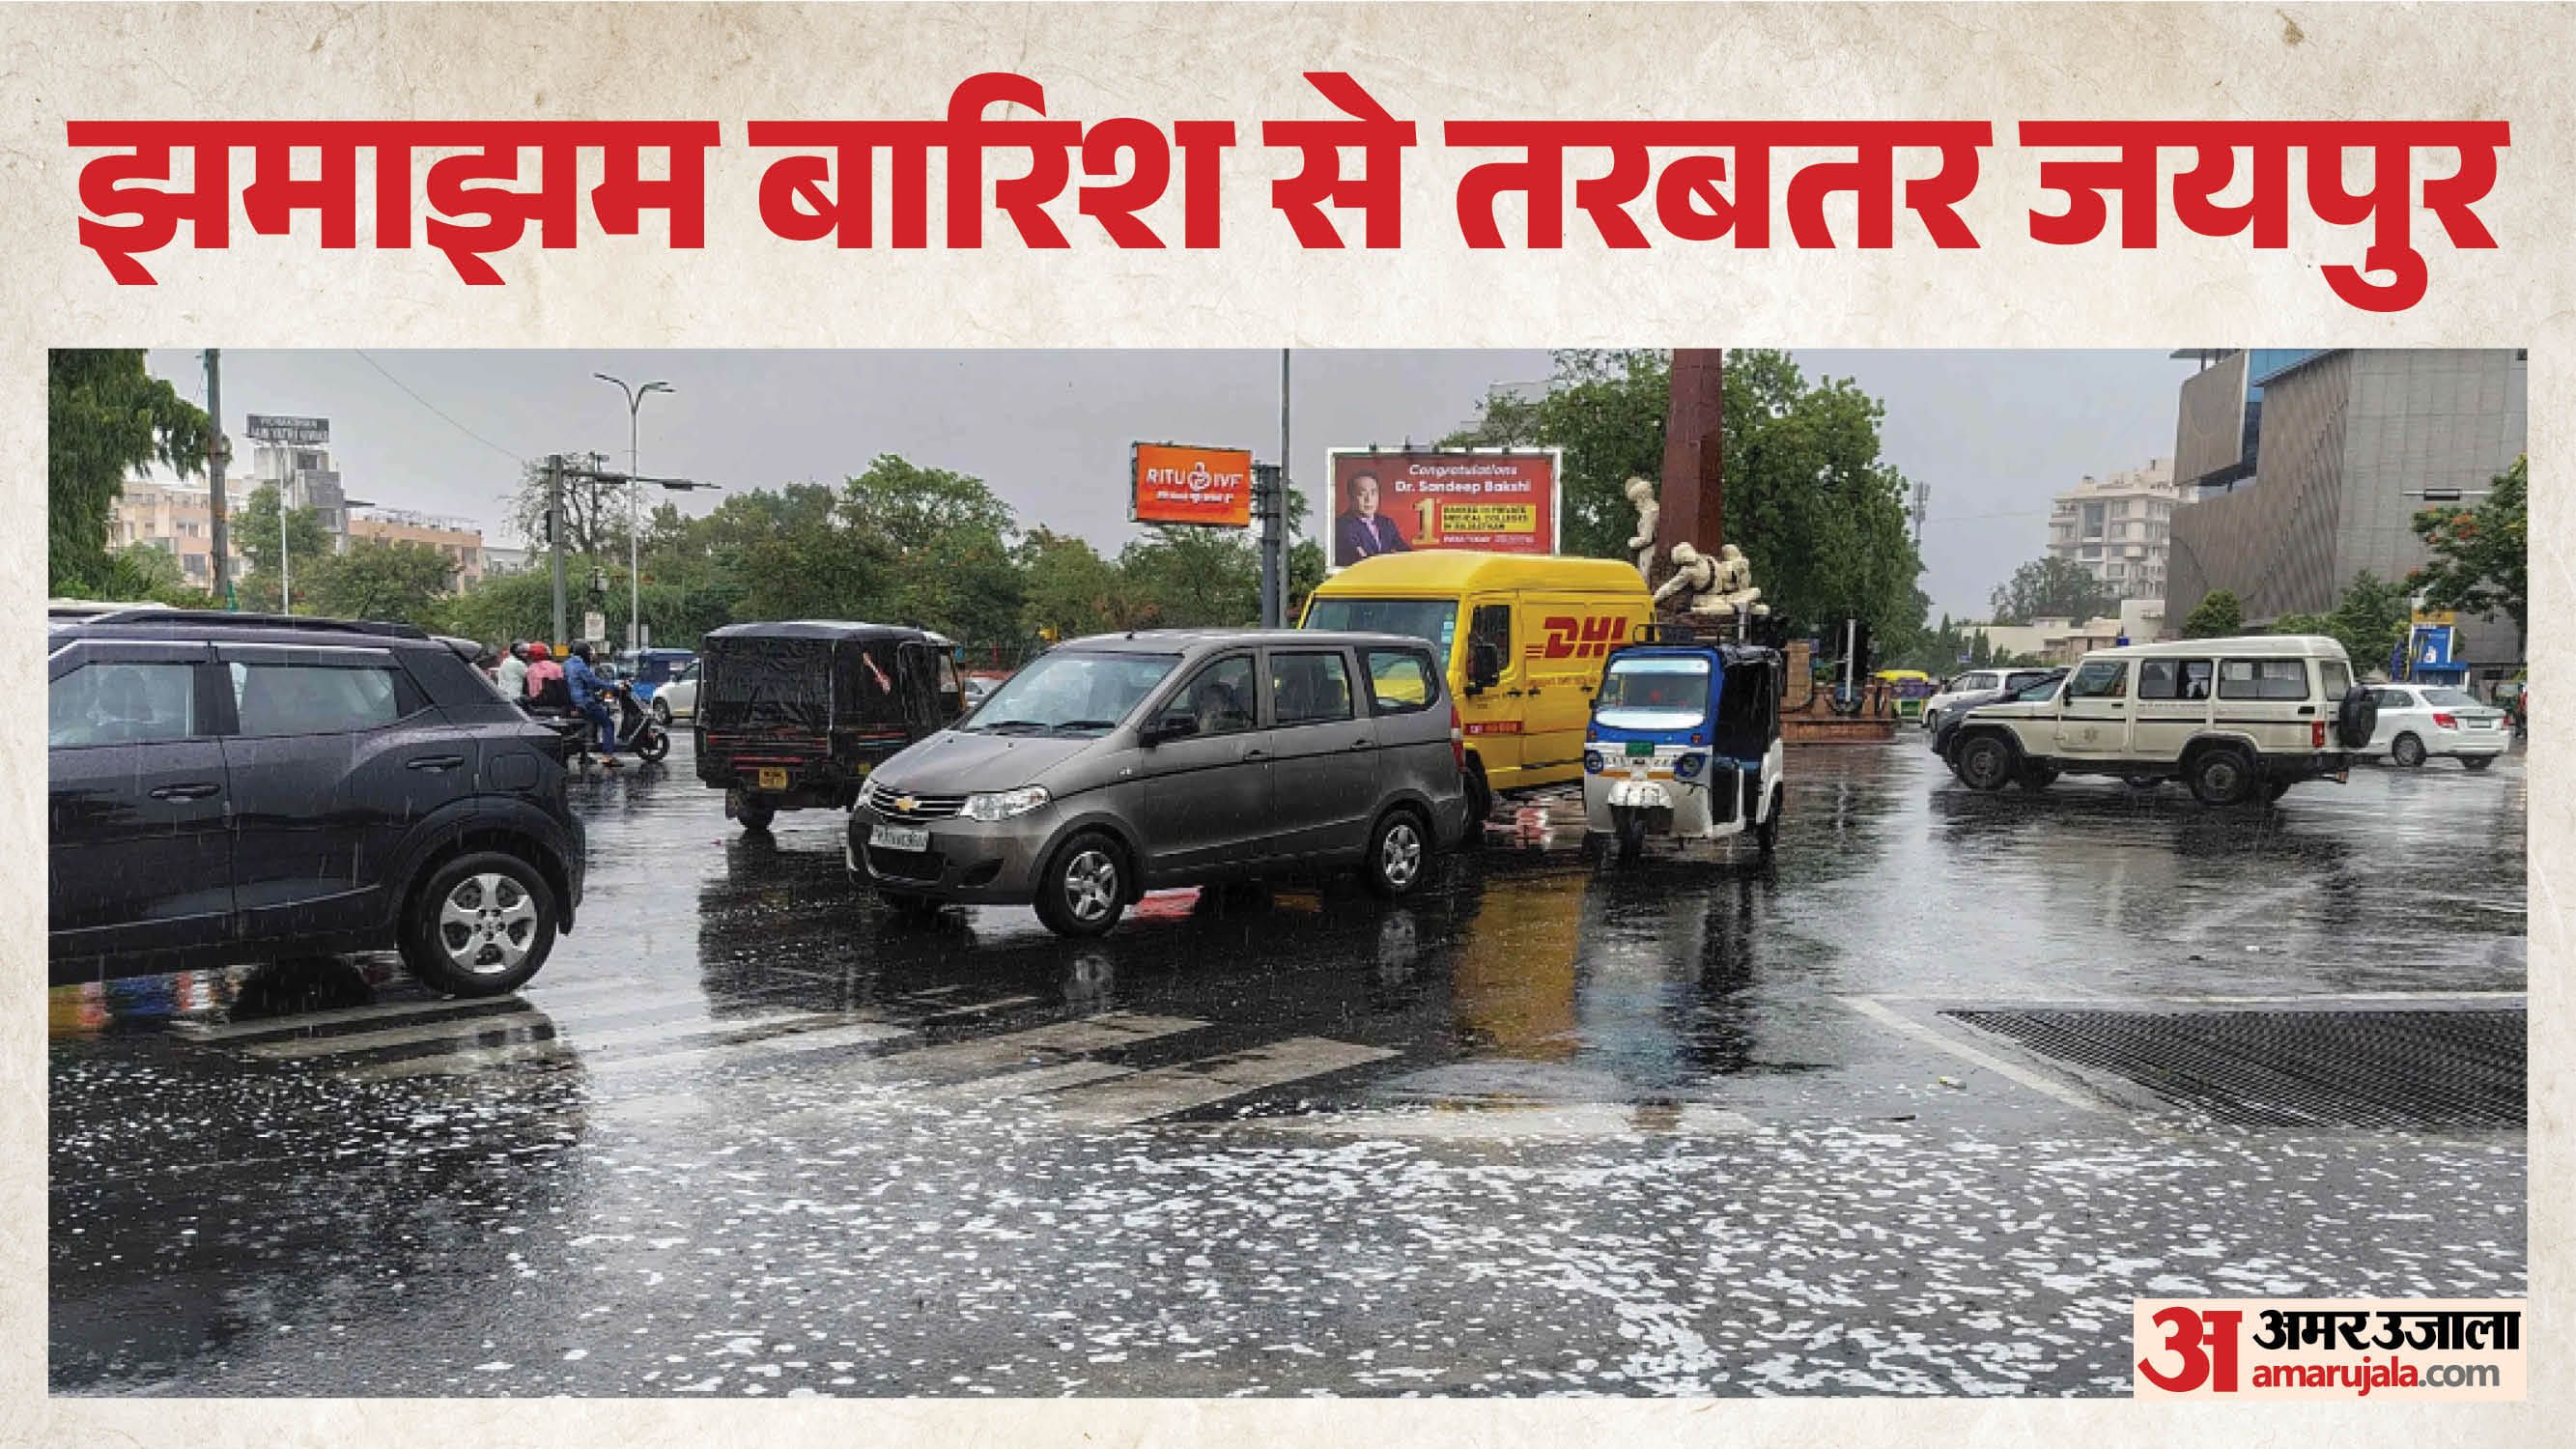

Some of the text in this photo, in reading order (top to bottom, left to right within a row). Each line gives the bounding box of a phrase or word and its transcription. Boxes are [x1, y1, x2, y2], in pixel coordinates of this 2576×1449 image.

[1146, 469, 1244, 487] RITU IVF
[1409, 464, 1517, 479] Congratulations
[1395, 479, 1532, 494] Dr. Sandeep Bakshi
[1543, 617, 1630, 658] DHL
